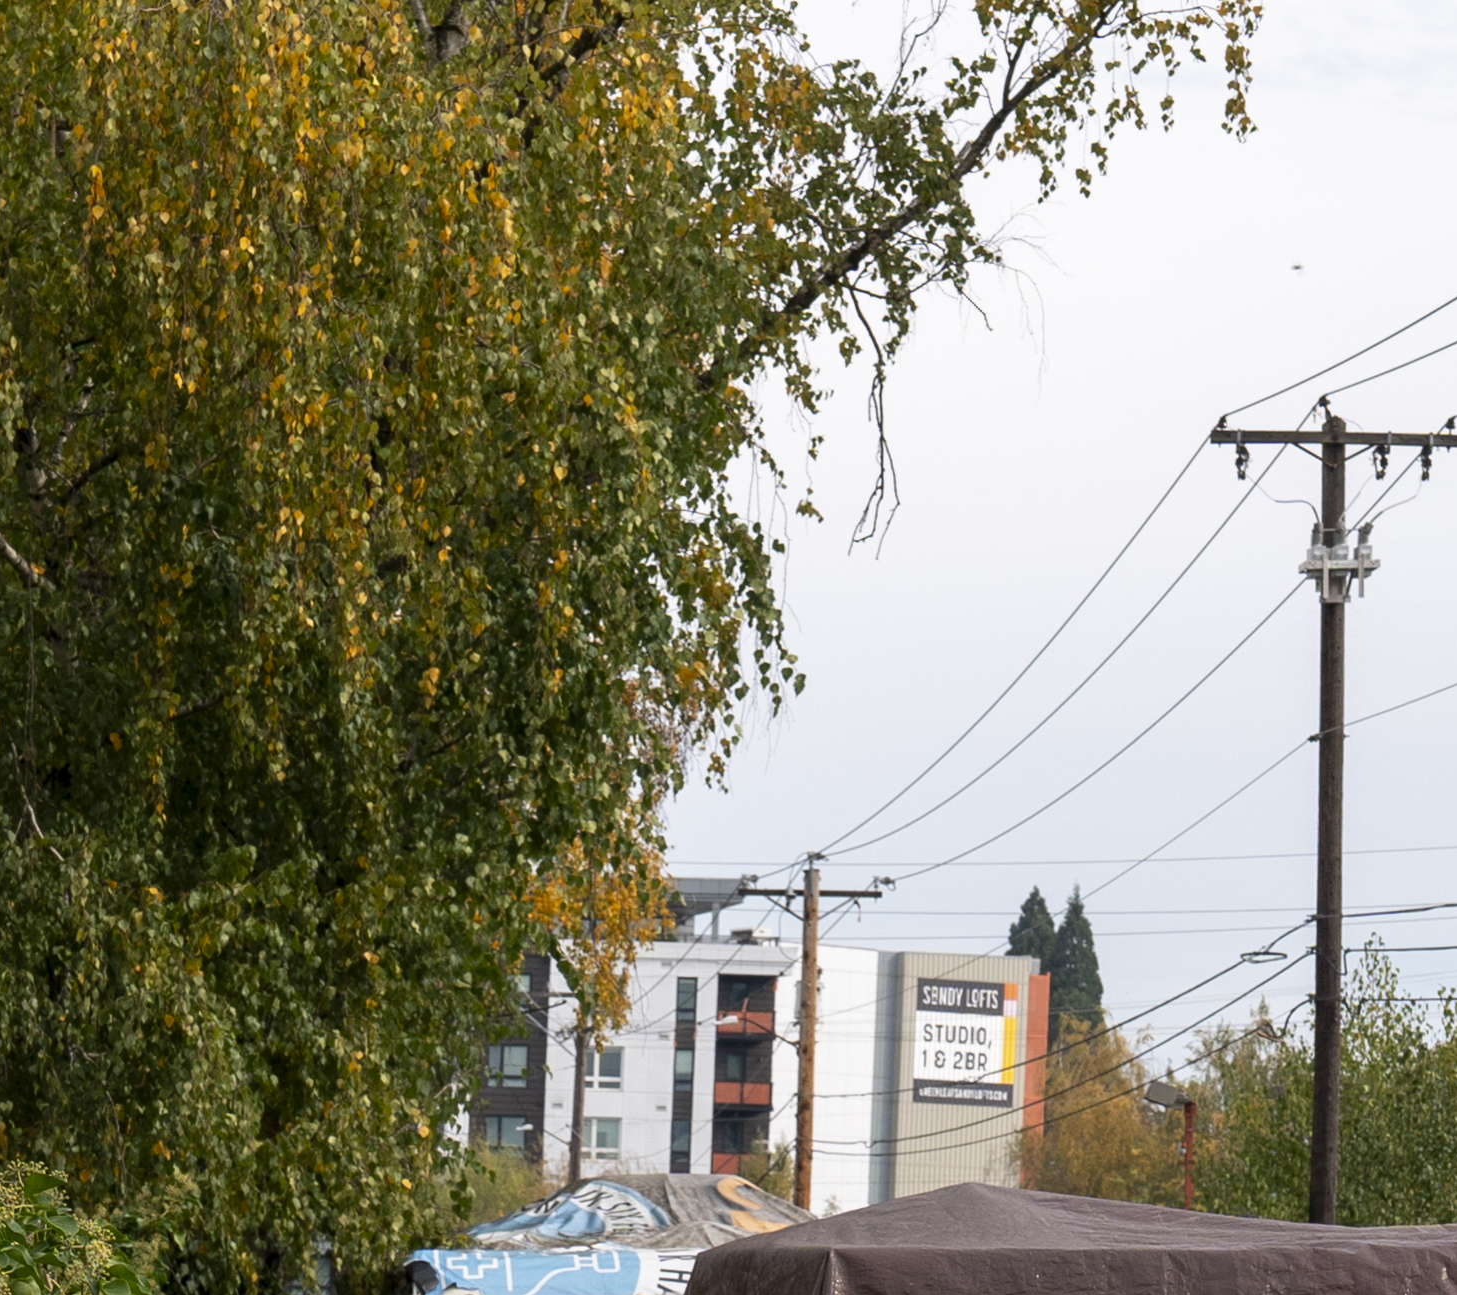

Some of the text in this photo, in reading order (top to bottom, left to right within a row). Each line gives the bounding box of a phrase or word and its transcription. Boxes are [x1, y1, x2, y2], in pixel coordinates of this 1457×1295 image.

[922, 985, 999, 1010] SANDY LOFTS
[923, 1023, 992, 1049] STUDIO,
[922, 1049, 988, 1072] 1 & 2BR
